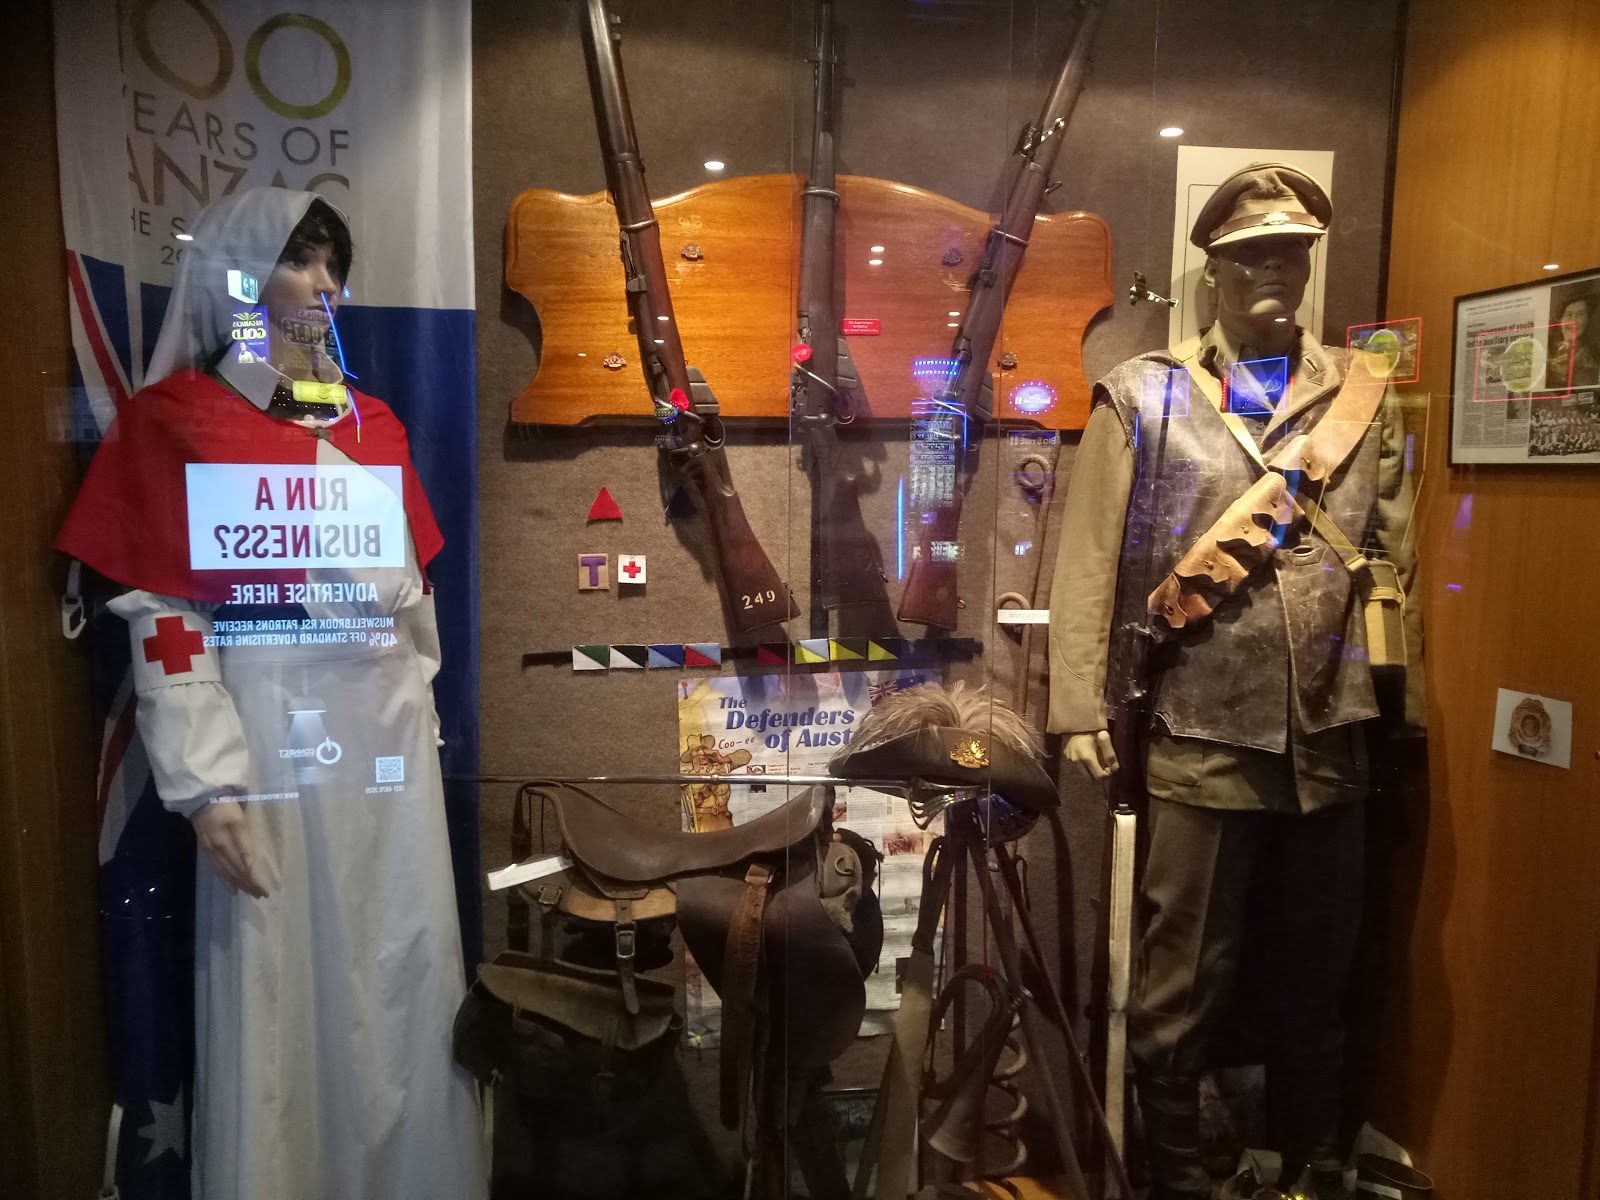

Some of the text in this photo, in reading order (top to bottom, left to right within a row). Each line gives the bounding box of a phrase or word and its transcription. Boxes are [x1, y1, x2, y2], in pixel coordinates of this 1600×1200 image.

[122, 84, 349, 166] EARS OF
[580, 556, 606, 587] T
[741, 590, 776, 610] 249
[718, 697, 747, 709] The
[725, 706, 855, 733] Defenders
[764, 728, 852, 752] of Aust
